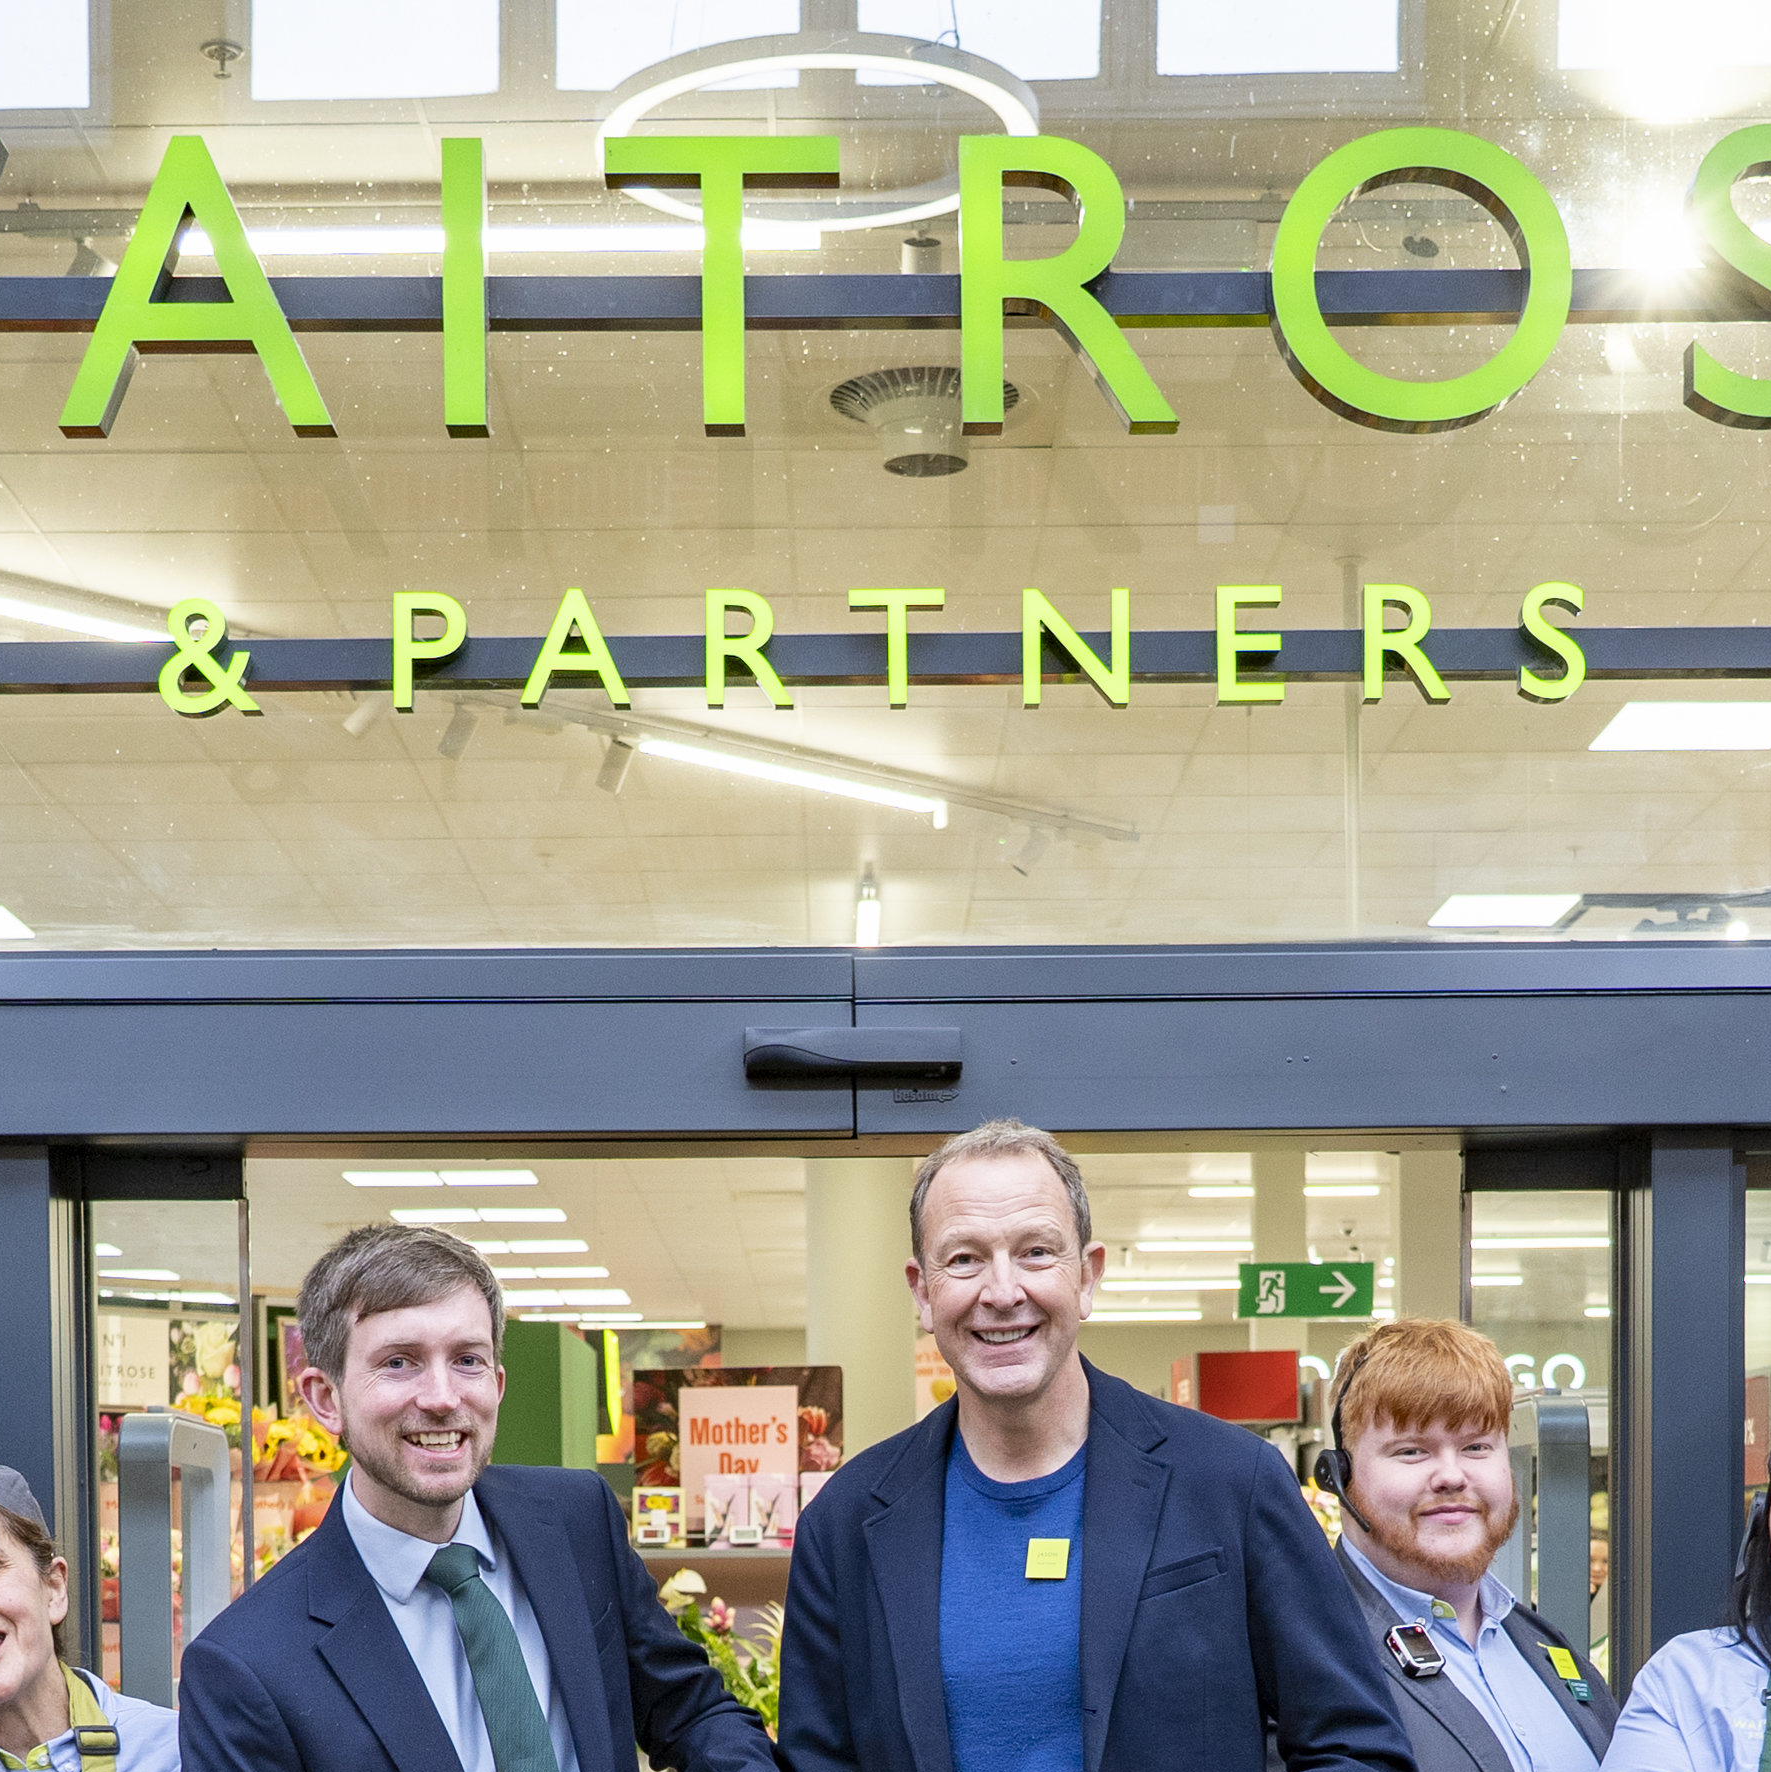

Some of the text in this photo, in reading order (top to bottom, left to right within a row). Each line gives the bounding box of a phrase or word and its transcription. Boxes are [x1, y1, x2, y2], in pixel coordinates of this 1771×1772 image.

[159, 583, 1587, 715] & PARTNERS
[689, 1416, 788, 1445] Mother's
[719, 1452, 759, 1475] Day
